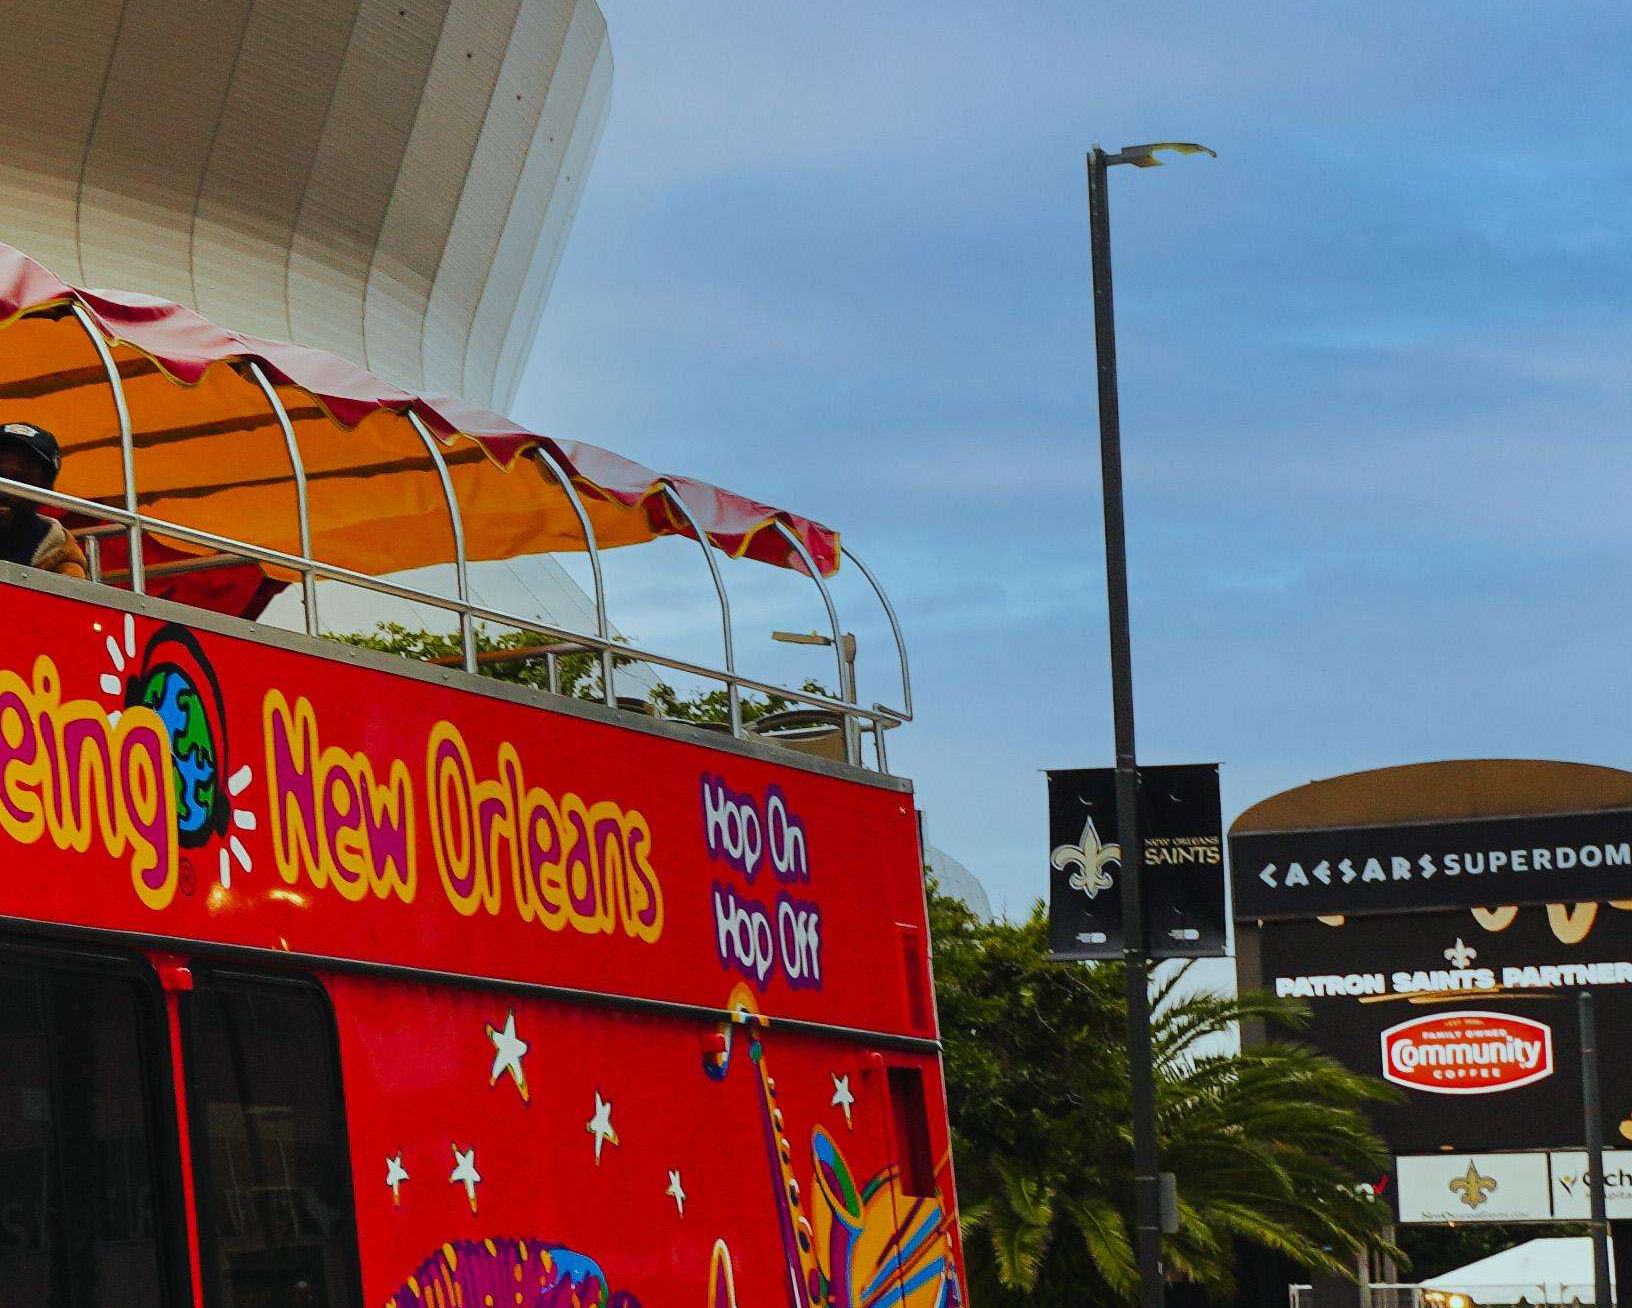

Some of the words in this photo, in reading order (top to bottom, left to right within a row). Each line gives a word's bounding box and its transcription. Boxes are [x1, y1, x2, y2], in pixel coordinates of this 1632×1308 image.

[263, 688, 416, 903] New
[426, 719, 664, 945] Orleans
[704, 781, 761, 874] Hop
[767, 791, 807, 876] On
[1144, 846, 1221, 865] SAINTS
[1258, 853, 1438, 888] CAESARS
[713, 891, 773, 981] Hop
[778, 901, 822, 981] Off
[1275, 973, 1385, 997] PATRON
[1392, 968, 1496, 993] SAINTS
[1391, 1035, 1541, 1073] Community
